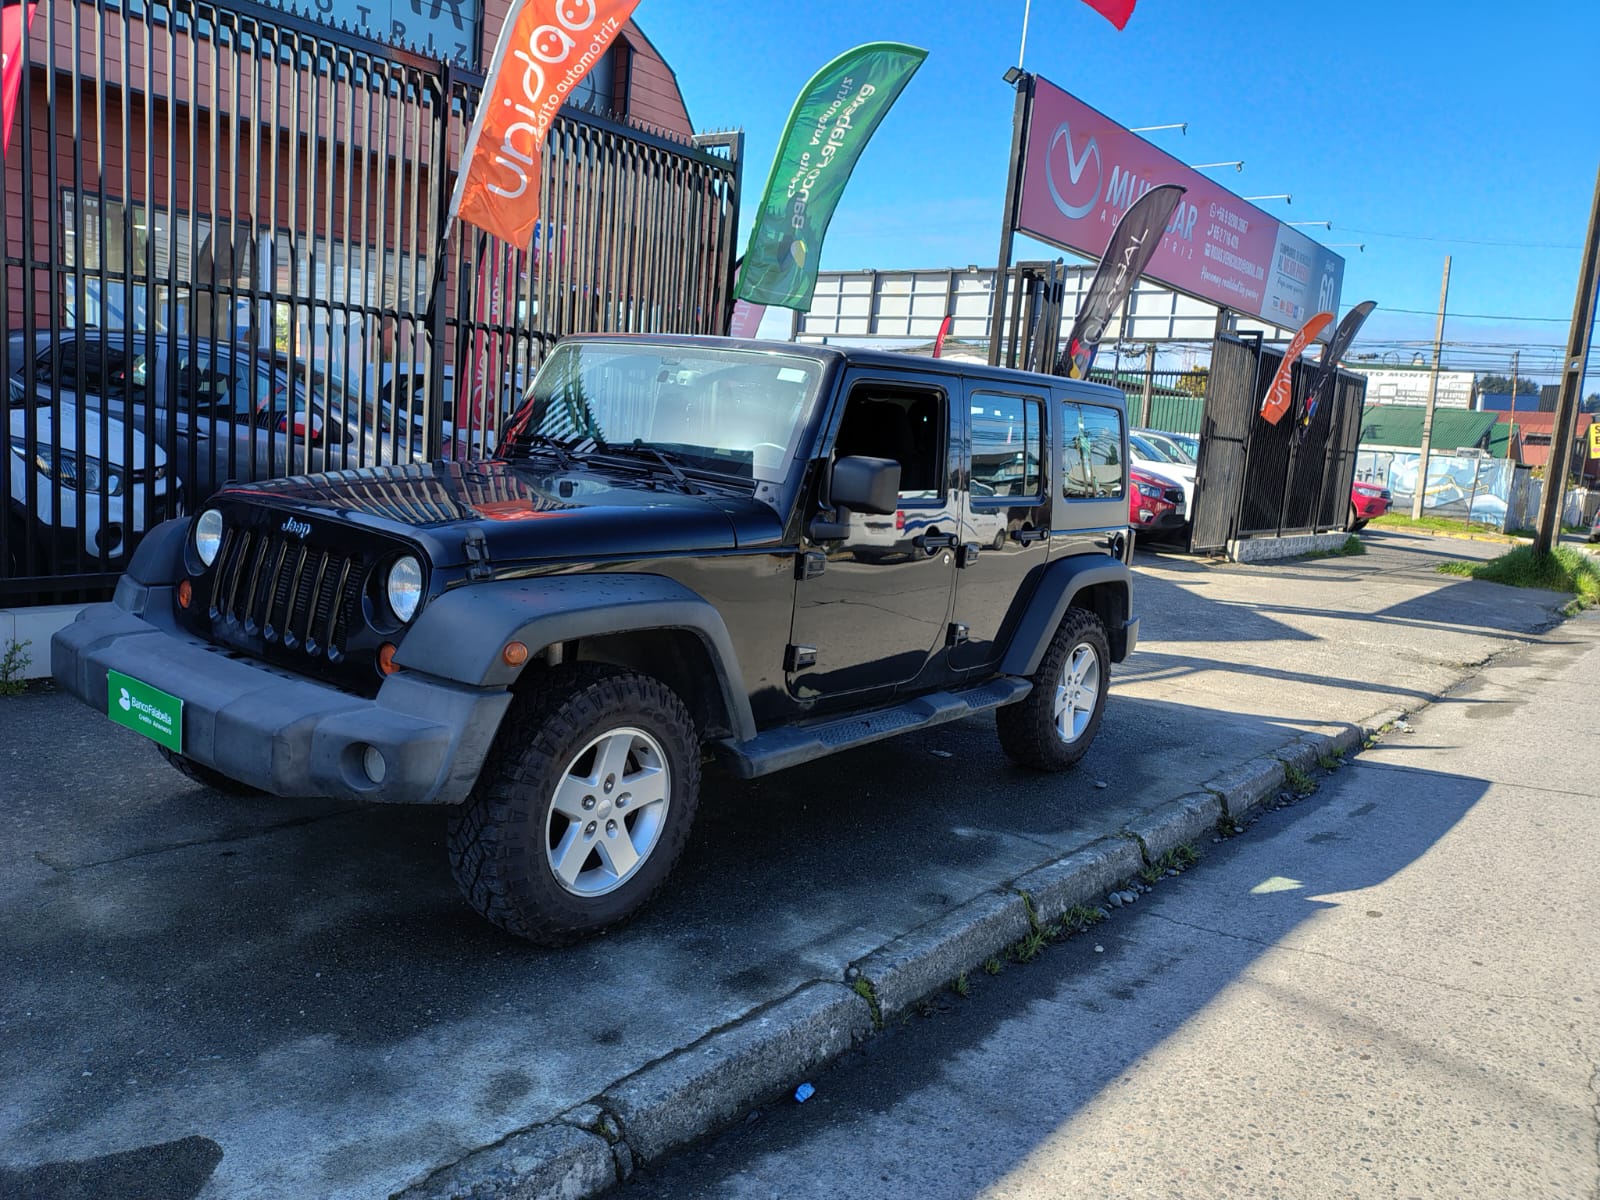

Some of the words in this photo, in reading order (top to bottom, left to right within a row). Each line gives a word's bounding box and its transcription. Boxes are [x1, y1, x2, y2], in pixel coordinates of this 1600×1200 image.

[556, 15, 621, 93] automotriz
[1100, 209, 1193, 260] AUTRIZ
[281, 516, 311, 539] Jeep
